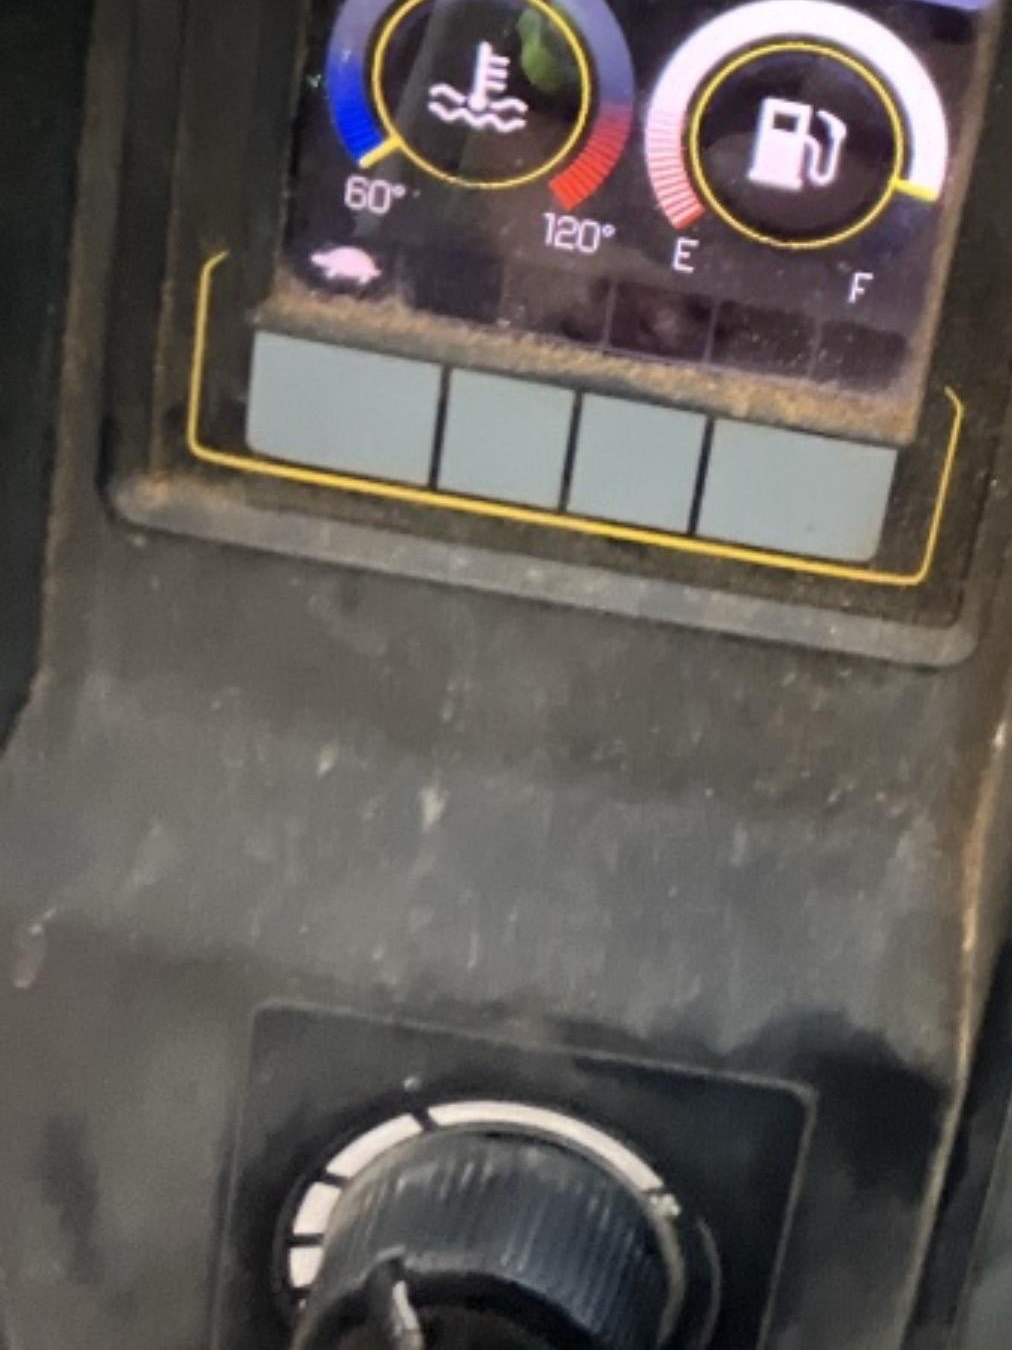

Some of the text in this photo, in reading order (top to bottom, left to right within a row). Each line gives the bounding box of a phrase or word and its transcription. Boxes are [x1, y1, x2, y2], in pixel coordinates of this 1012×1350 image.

[343, 176, 406, 215] 60°
[542, 211, 616, 255] 120°
[671, 237, 700, 274] E
[847, 272, 874, 305] F
